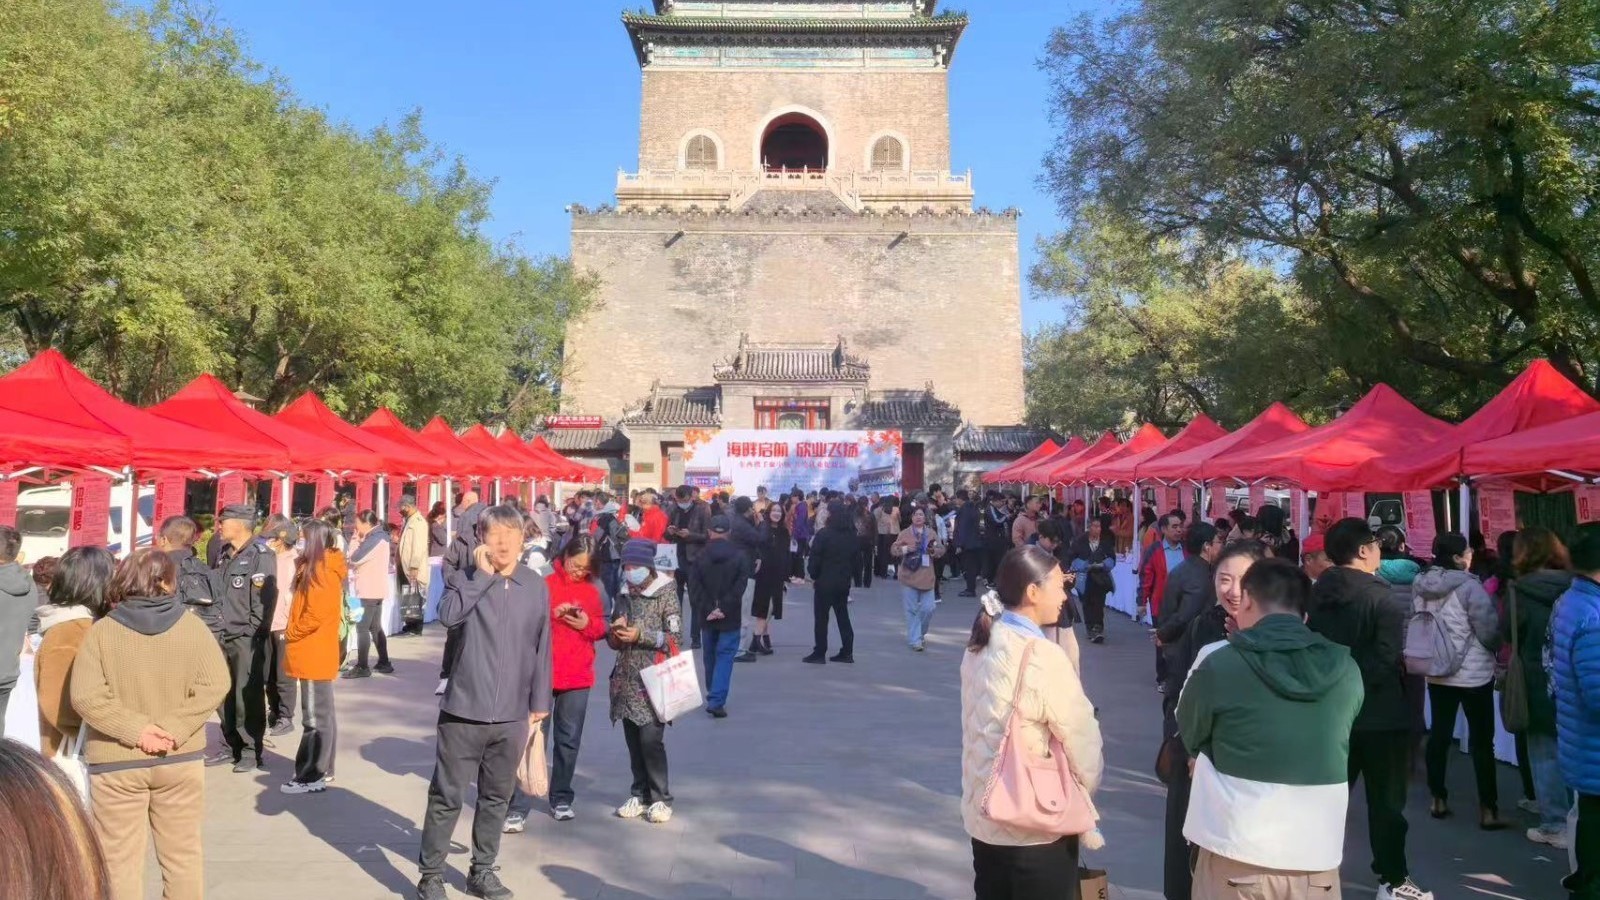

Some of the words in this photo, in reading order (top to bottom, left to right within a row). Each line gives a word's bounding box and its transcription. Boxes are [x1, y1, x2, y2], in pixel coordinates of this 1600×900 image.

[727, 441, 789, 458] 海畔启航
[796, 441, 860, 458] 欣业飞扬
